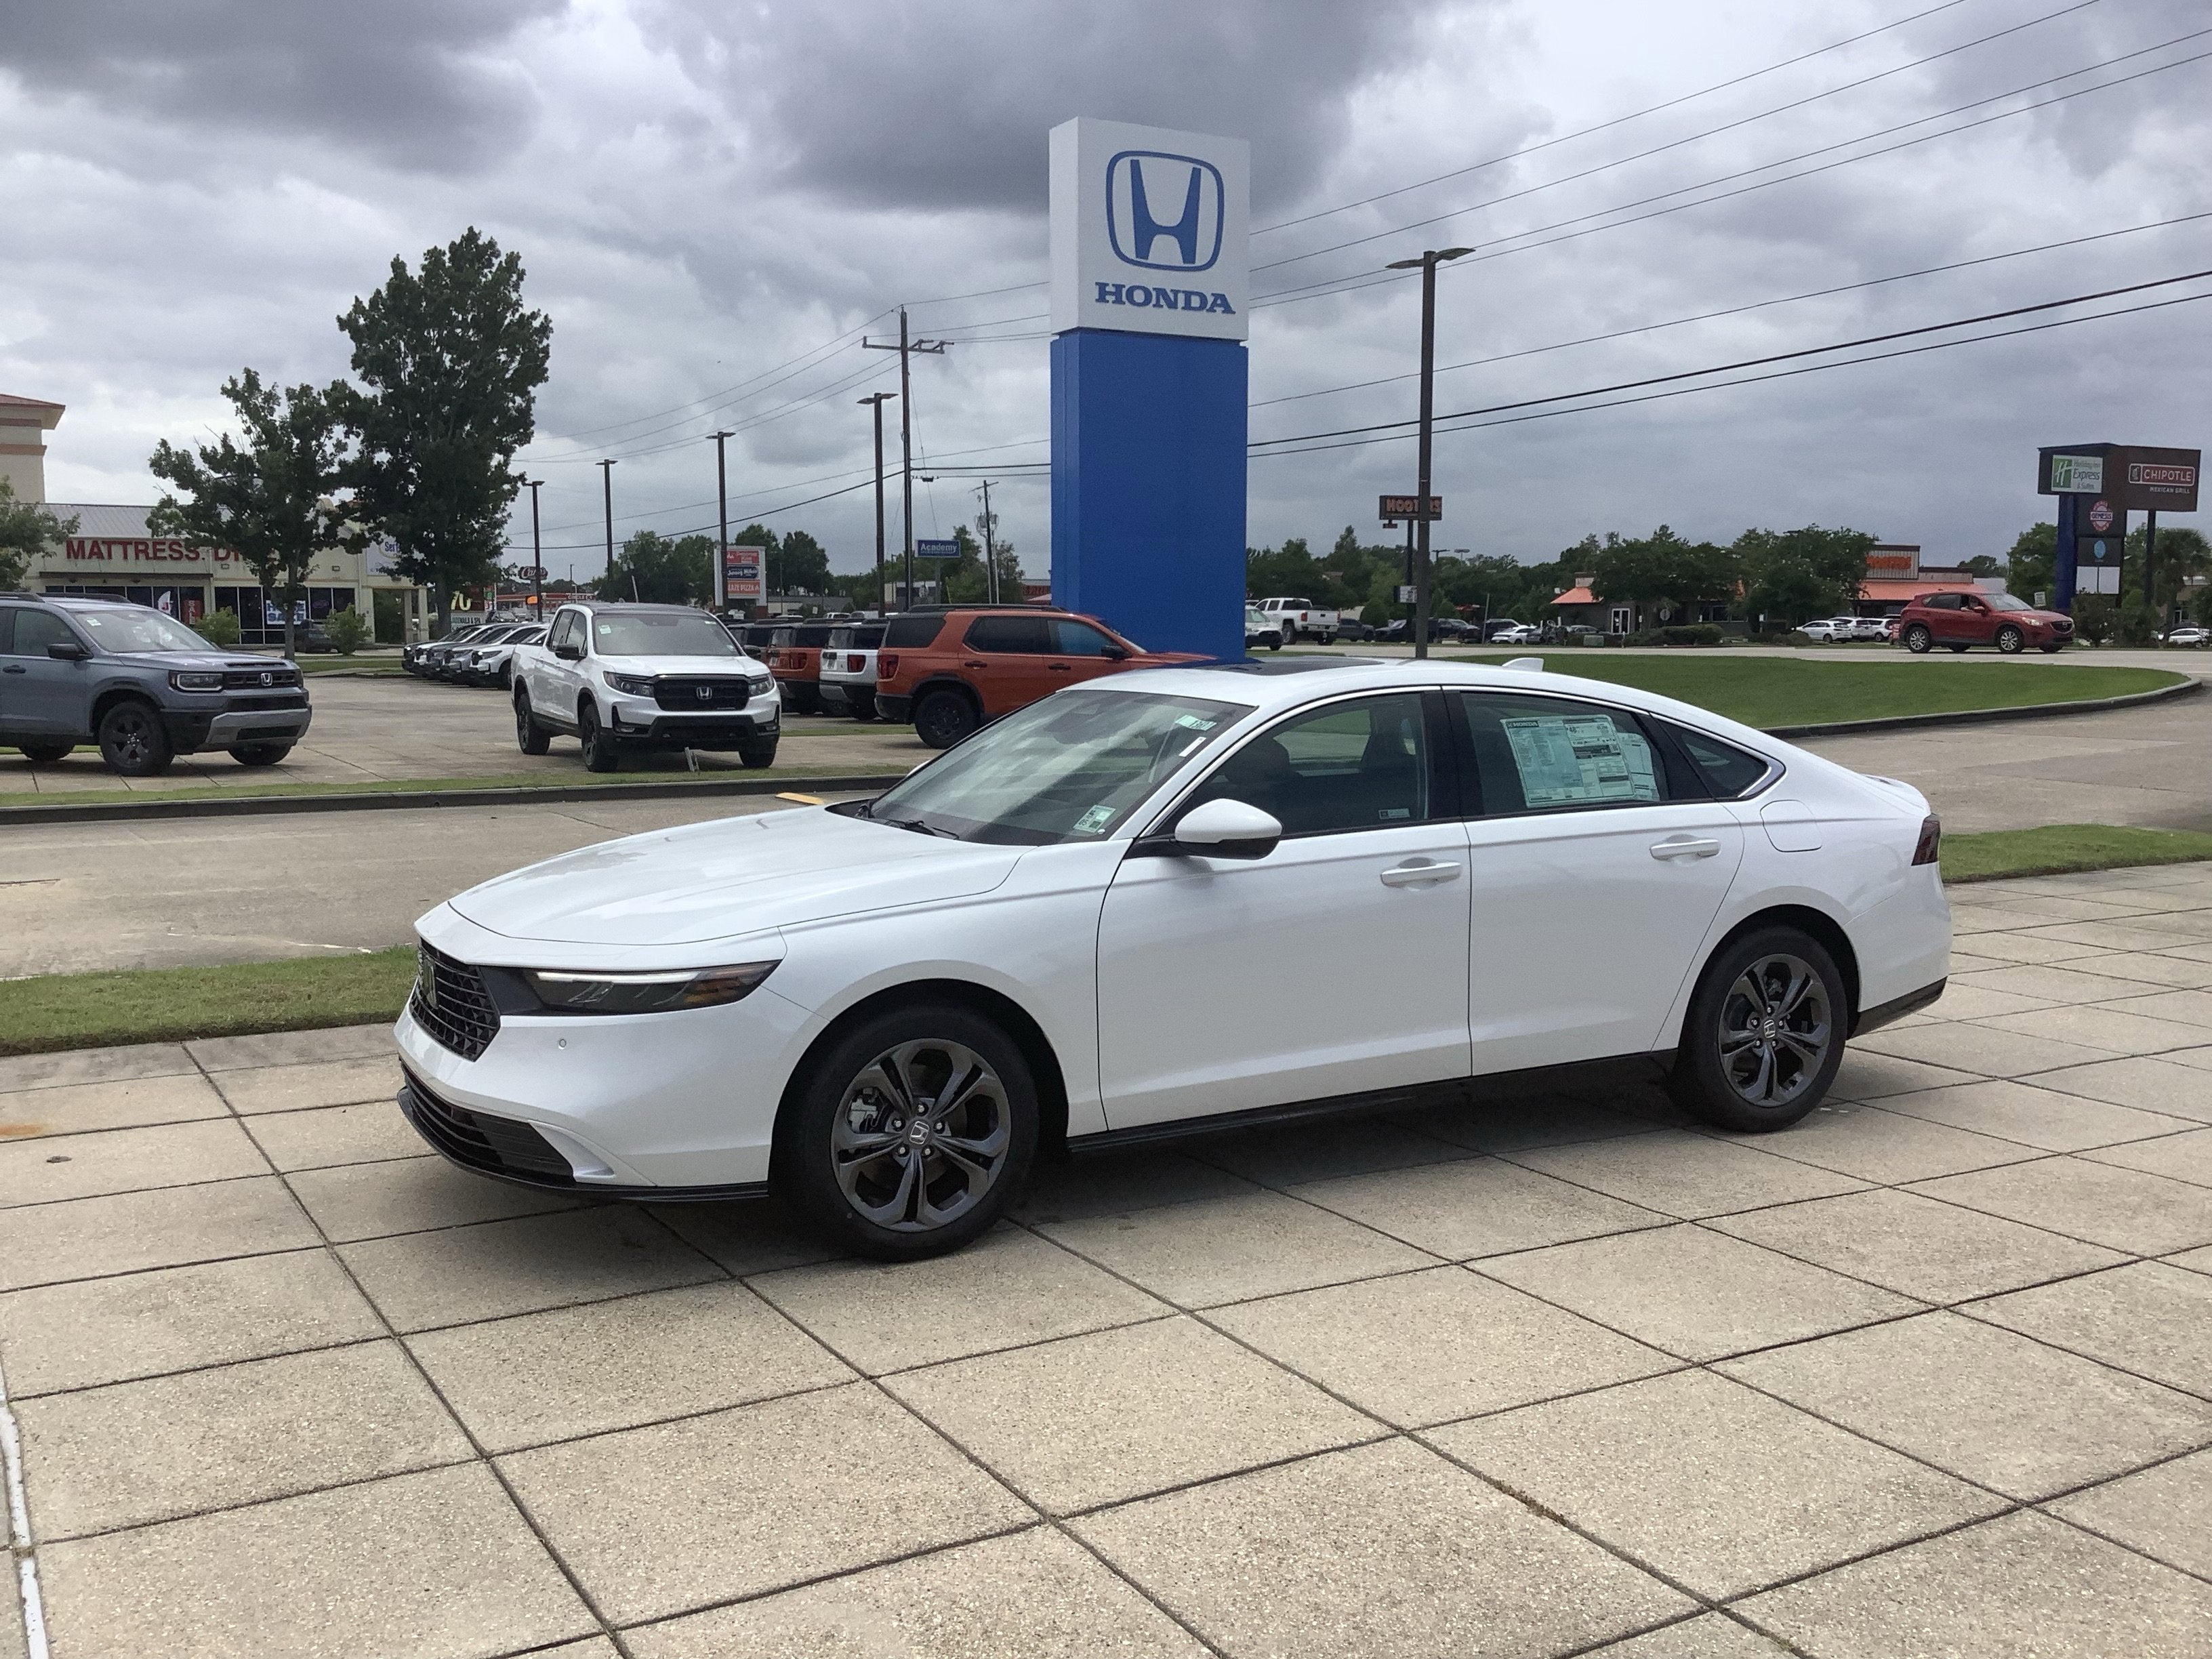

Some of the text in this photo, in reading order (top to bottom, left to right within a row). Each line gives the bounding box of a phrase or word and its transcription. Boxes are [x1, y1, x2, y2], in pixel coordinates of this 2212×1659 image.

[1095, 281, 1236, 314] HONDA
[2073, 468, 2100, 480] Express
[2144, 469, 2192, 482] CHIPOTLE
[66, 539, 201, 560] MATTRESS
[920, 543, 957, 552] Academy
